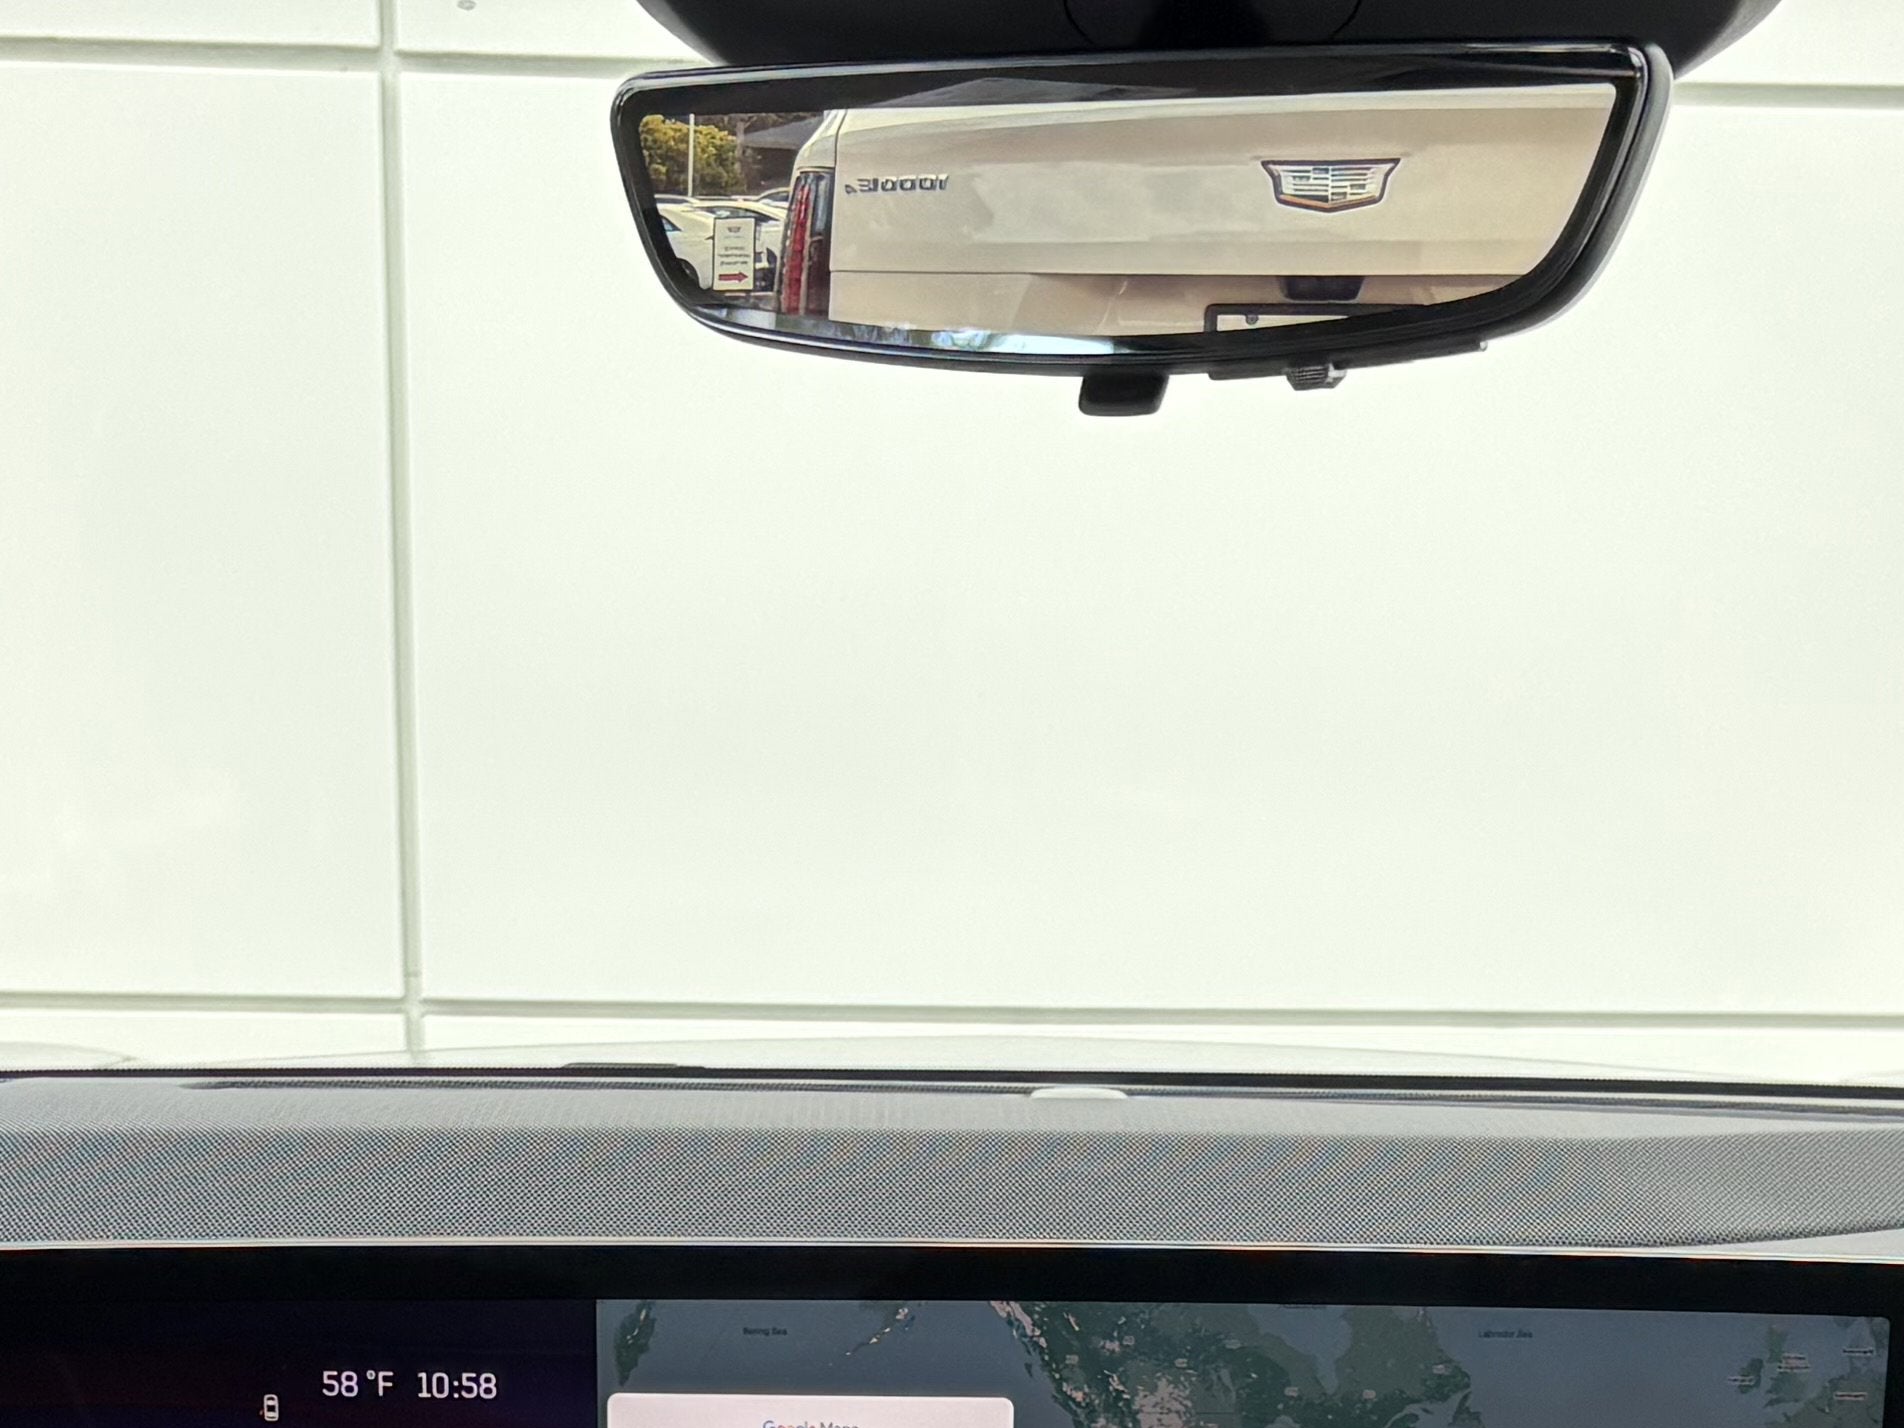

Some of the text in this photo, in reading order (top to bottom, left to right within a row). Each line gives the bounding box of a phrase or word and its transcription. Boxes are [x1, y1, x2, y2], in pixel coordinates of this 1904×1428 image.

[322, 1369, 497, 1399] 58 °F 10:58
